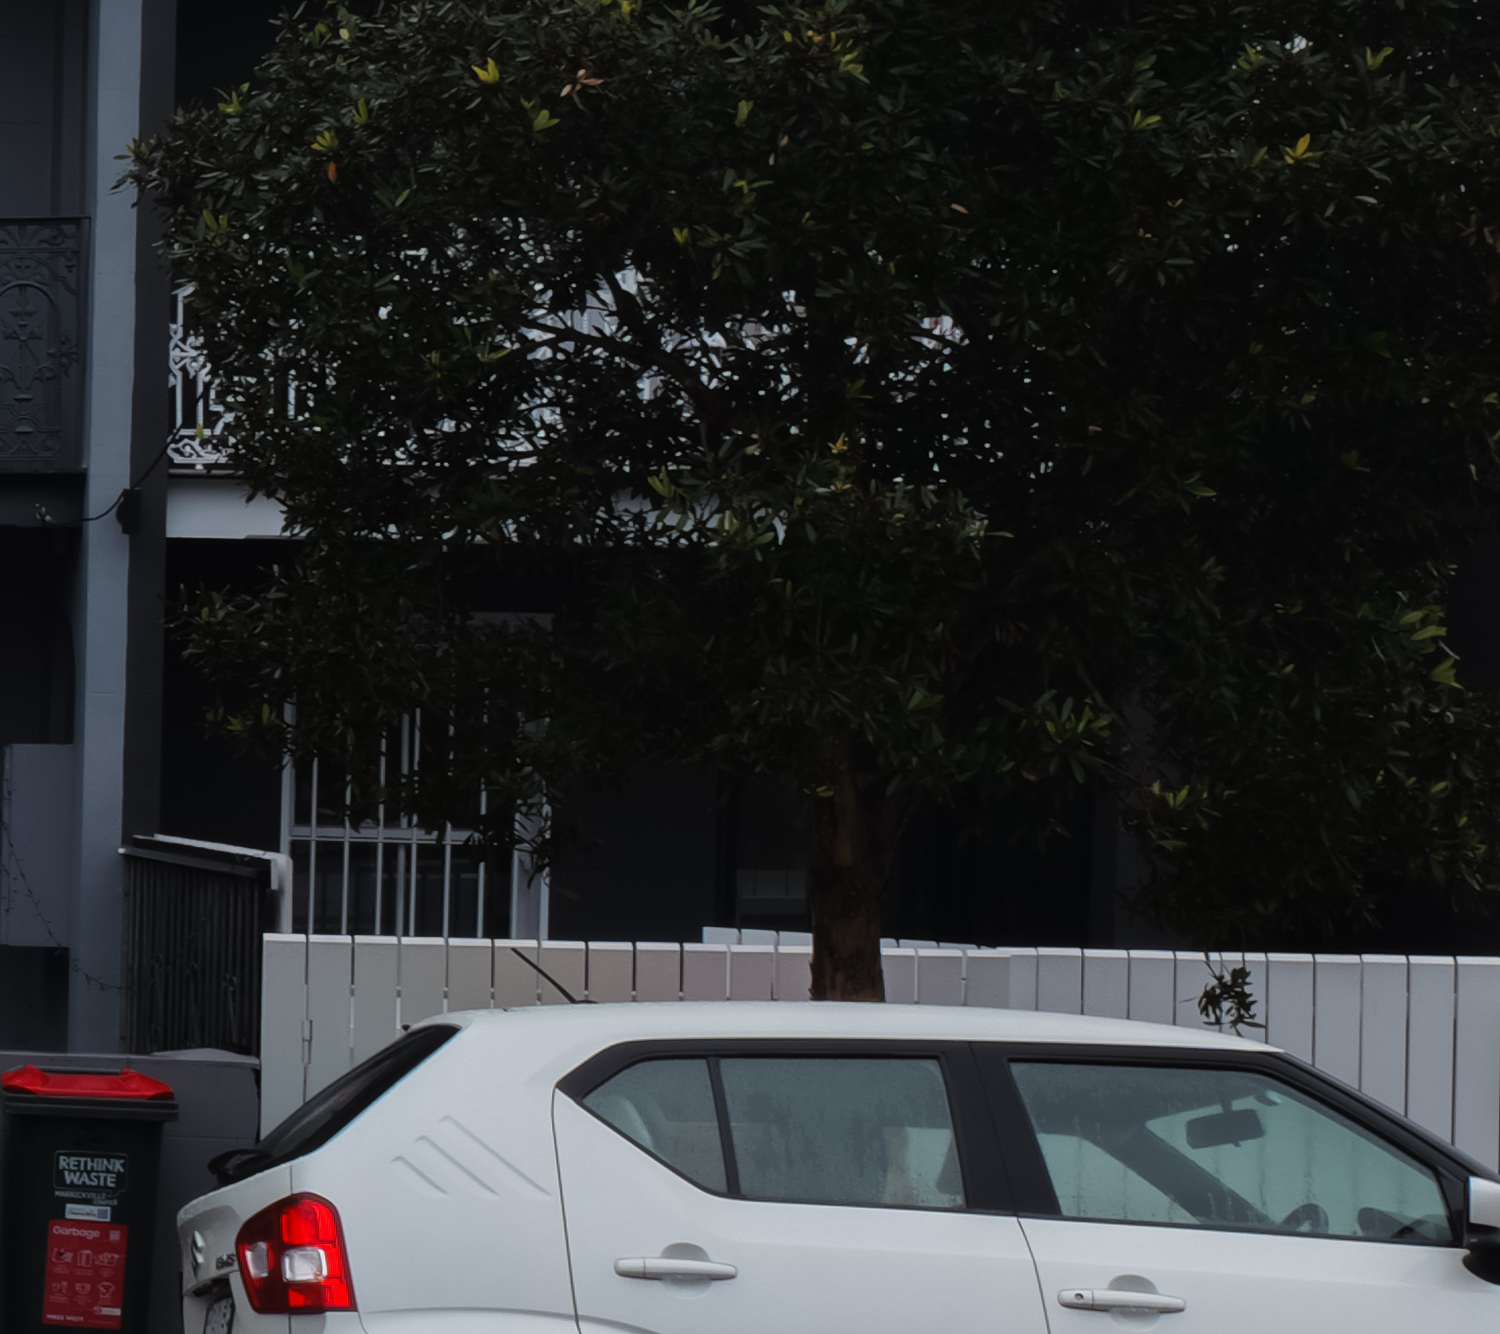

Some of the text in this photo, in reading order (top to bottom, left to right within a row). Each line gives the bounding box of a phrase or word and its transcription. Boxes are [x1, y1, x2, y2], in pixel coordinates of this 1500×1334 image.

[59, 1155, 126, 1172] RETHINK
[64, 1170, 117, 1188] WASTE
[52, 1225, 101, 1240] Garbage
